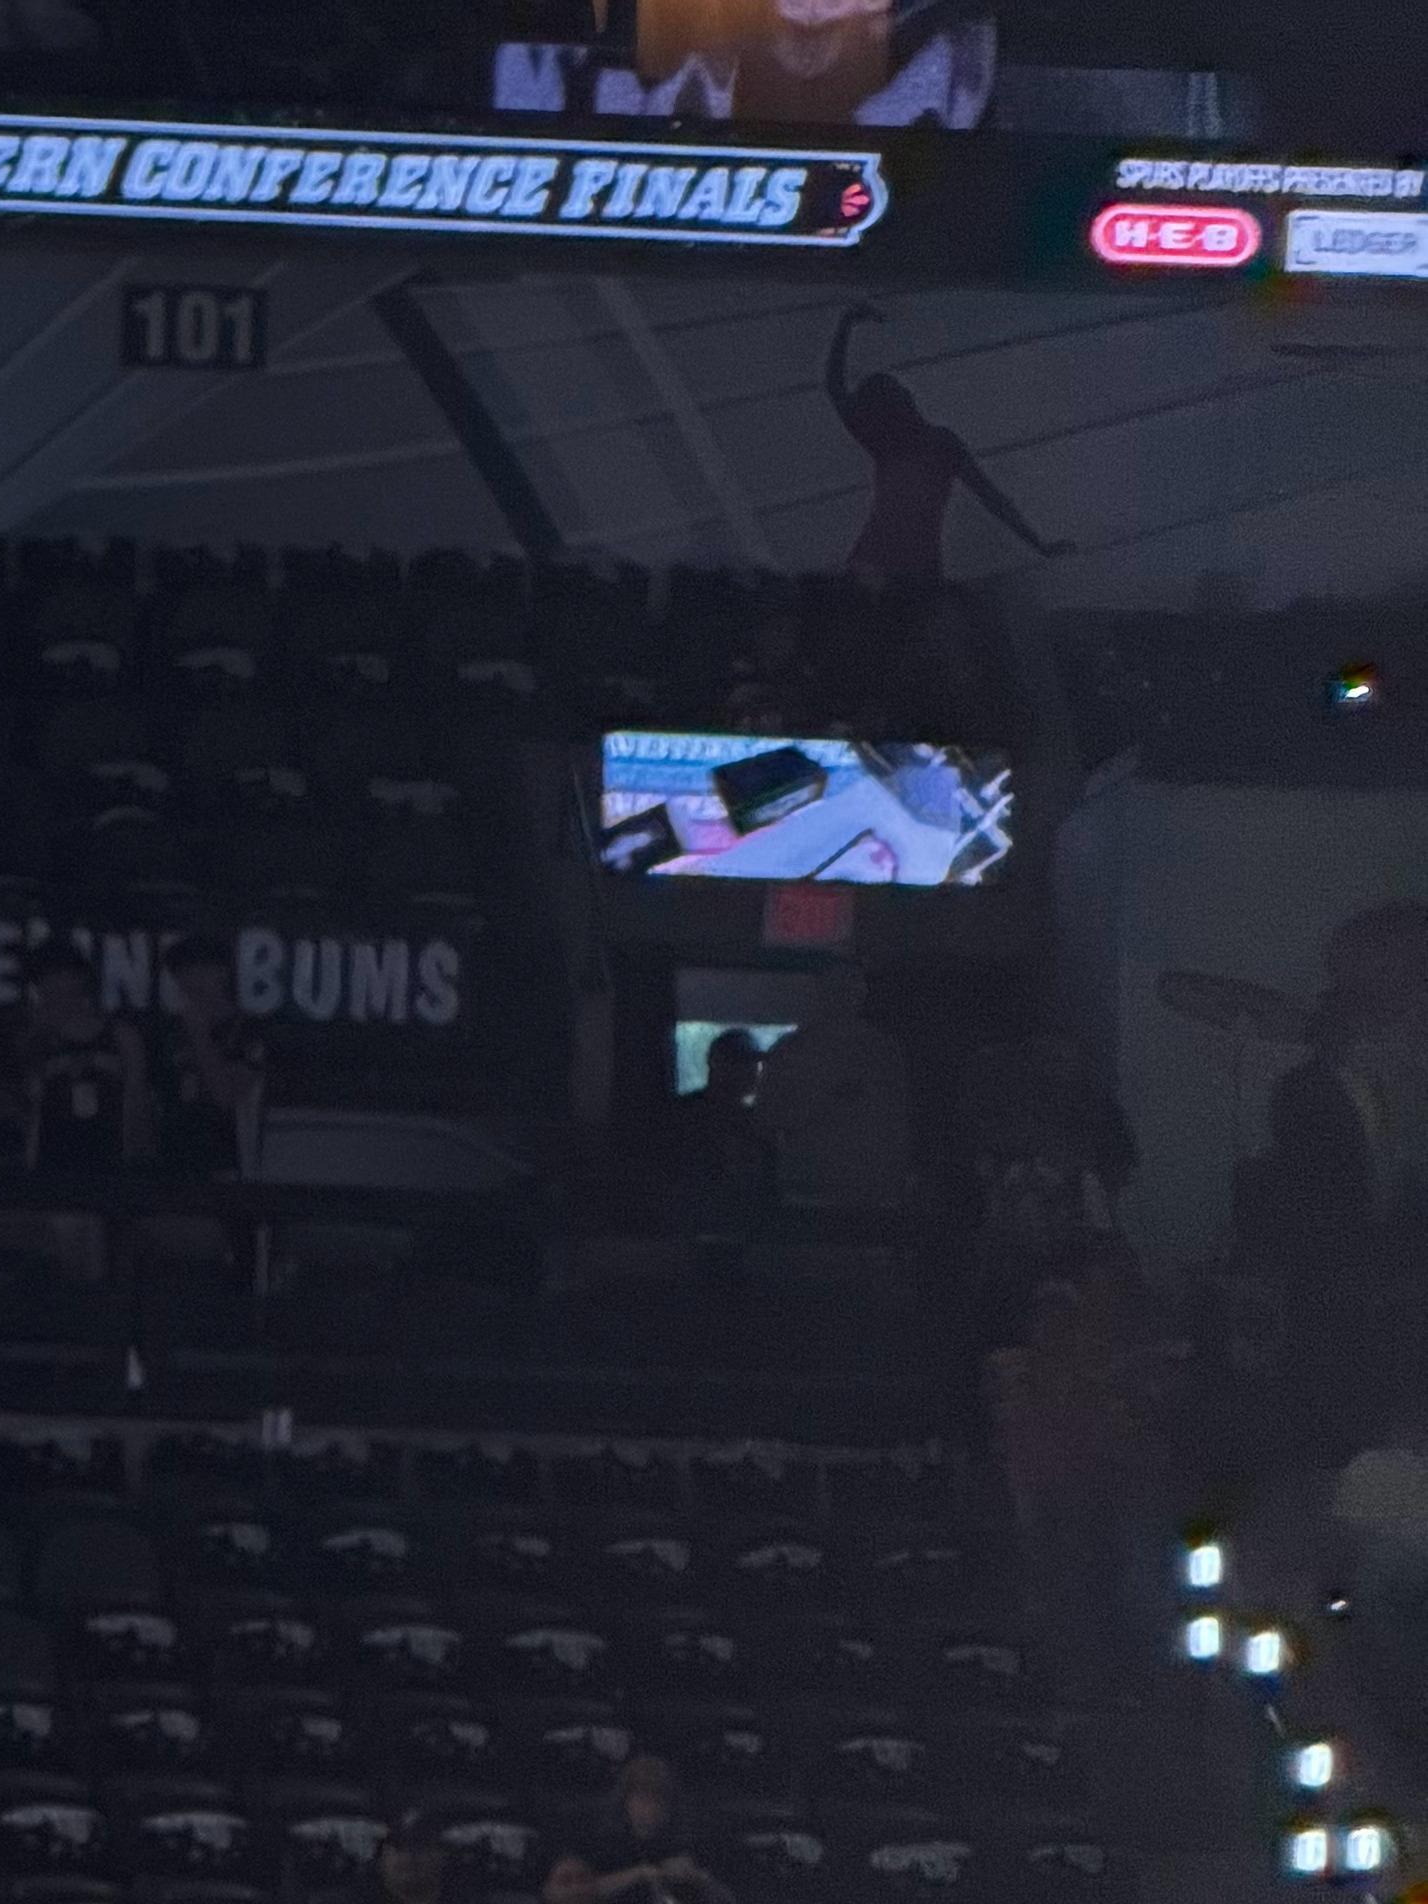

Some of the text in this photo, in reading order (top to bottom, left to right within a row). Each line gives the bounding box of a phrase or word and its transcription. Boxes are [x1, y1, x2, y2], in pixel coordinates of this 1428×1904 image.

[120, 139, 559, 217] CONFERENCE
[558, 157, 808, 227] FINALS
[131, 291, 251, 361] 101
[235, 926, 461, 1026] BUMS
